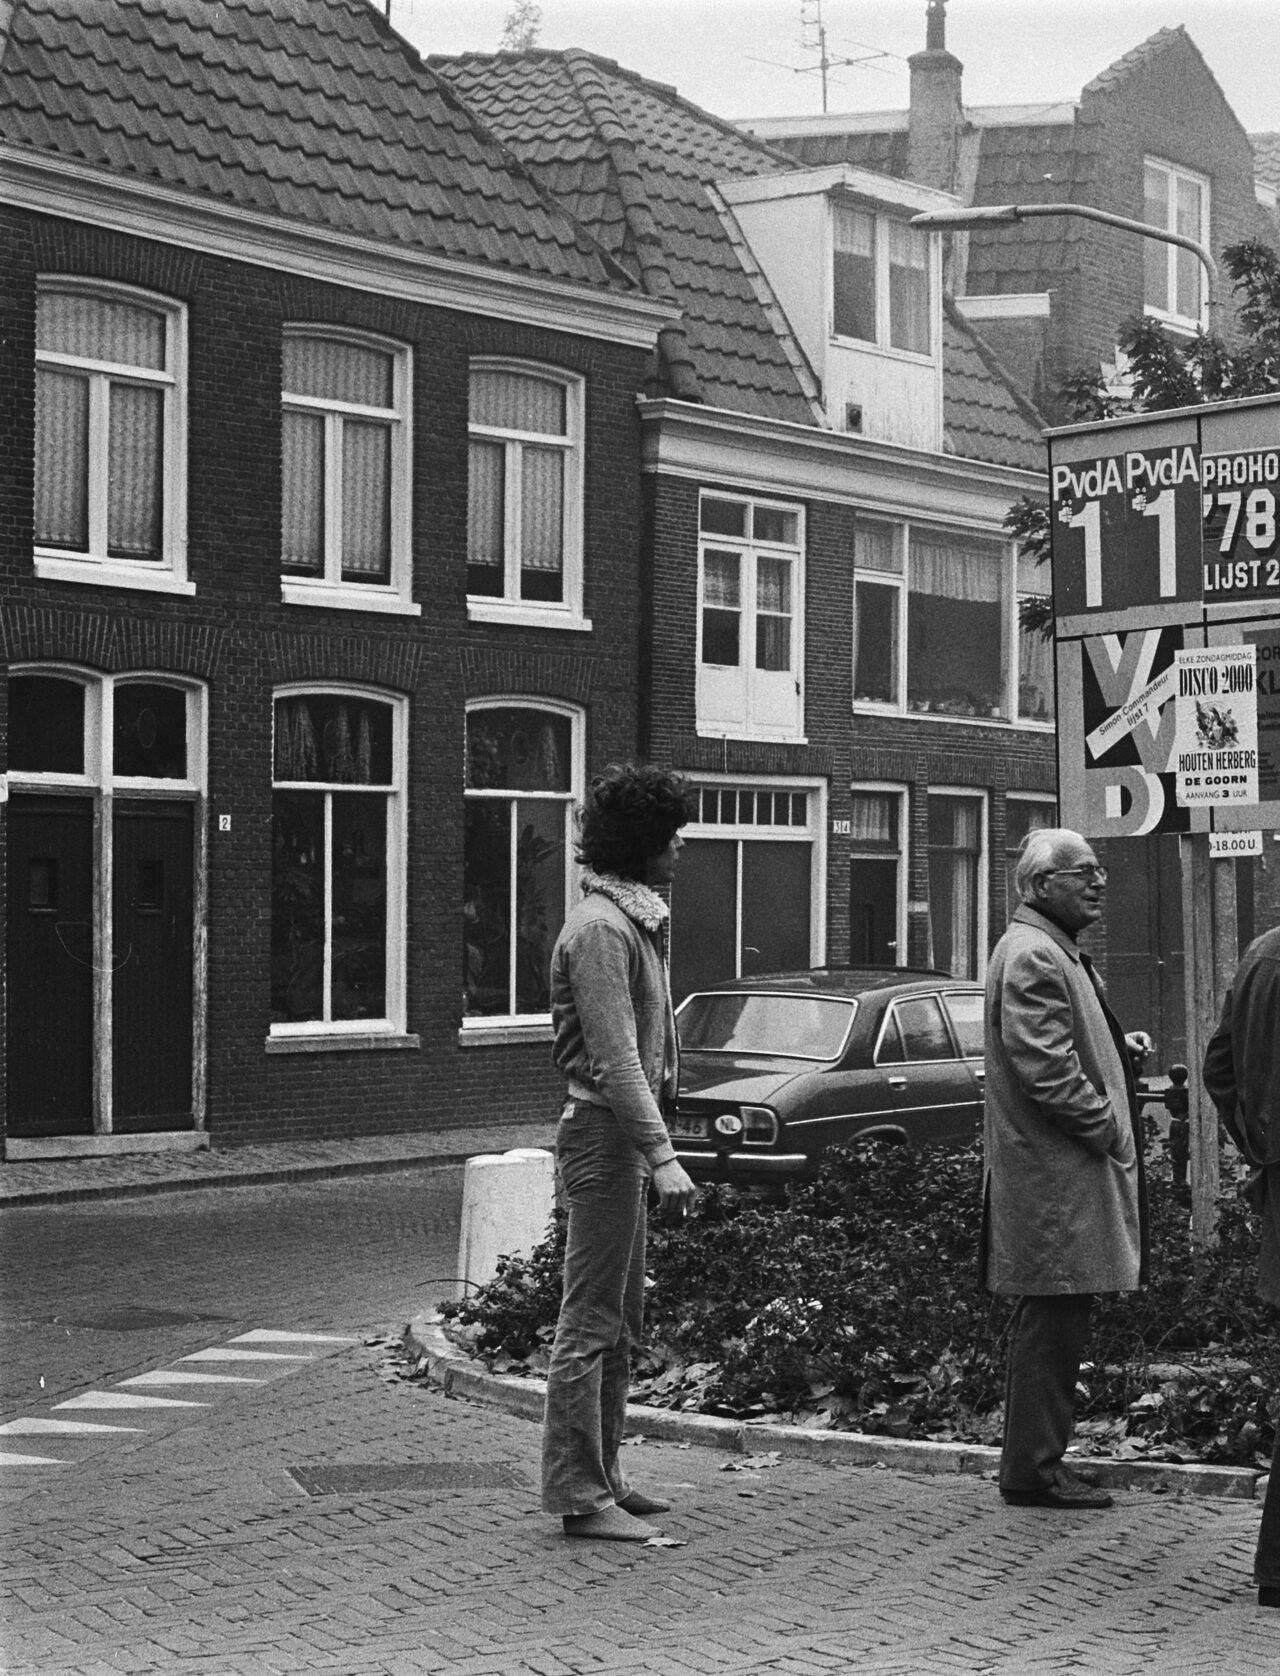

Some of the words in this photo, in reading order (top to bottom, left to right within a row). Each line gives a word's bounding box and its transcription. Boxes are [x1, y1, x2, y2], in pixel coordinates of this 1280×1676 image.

[1053, 458, 1124, 501] PvdA
[1126, 446, 1199, 489] PvdA
[1203, 453, 1279, 488] PROHO
[1069, 500, 1102, 608] 1
[1143, 489, 1177, 598] 1
[1204, 561, 1262, 591] LIJST
[1266, 559, 1280, 586] 2
[1179, 656, 1195, 664] ELKE
[1196, 652, 1253, 663] ZONDAGMIDDAG
[1179, 666, 1218, 697] DISCO
[1221, 664, 1253, 694] 2000
[1099, 714, 1122, 736] Simon
[1122, 674, 1169, 716] Commandeur
[1126, 708, 1144, 726] lijst
[1143, 703, 1150, 714] 7
[1179, 752, 1214, 772] HOUTEN
[1216, 750, 1256, 770] HERBERG
[1185, 777, 1201, 786] DE
[1205, 775, 1248, 785] GOORN
[1185, 790, 1220, 799] AANVANG
[1222, 790, 1230, 798] 3
[1233, 789, 1248, 798] UUR
